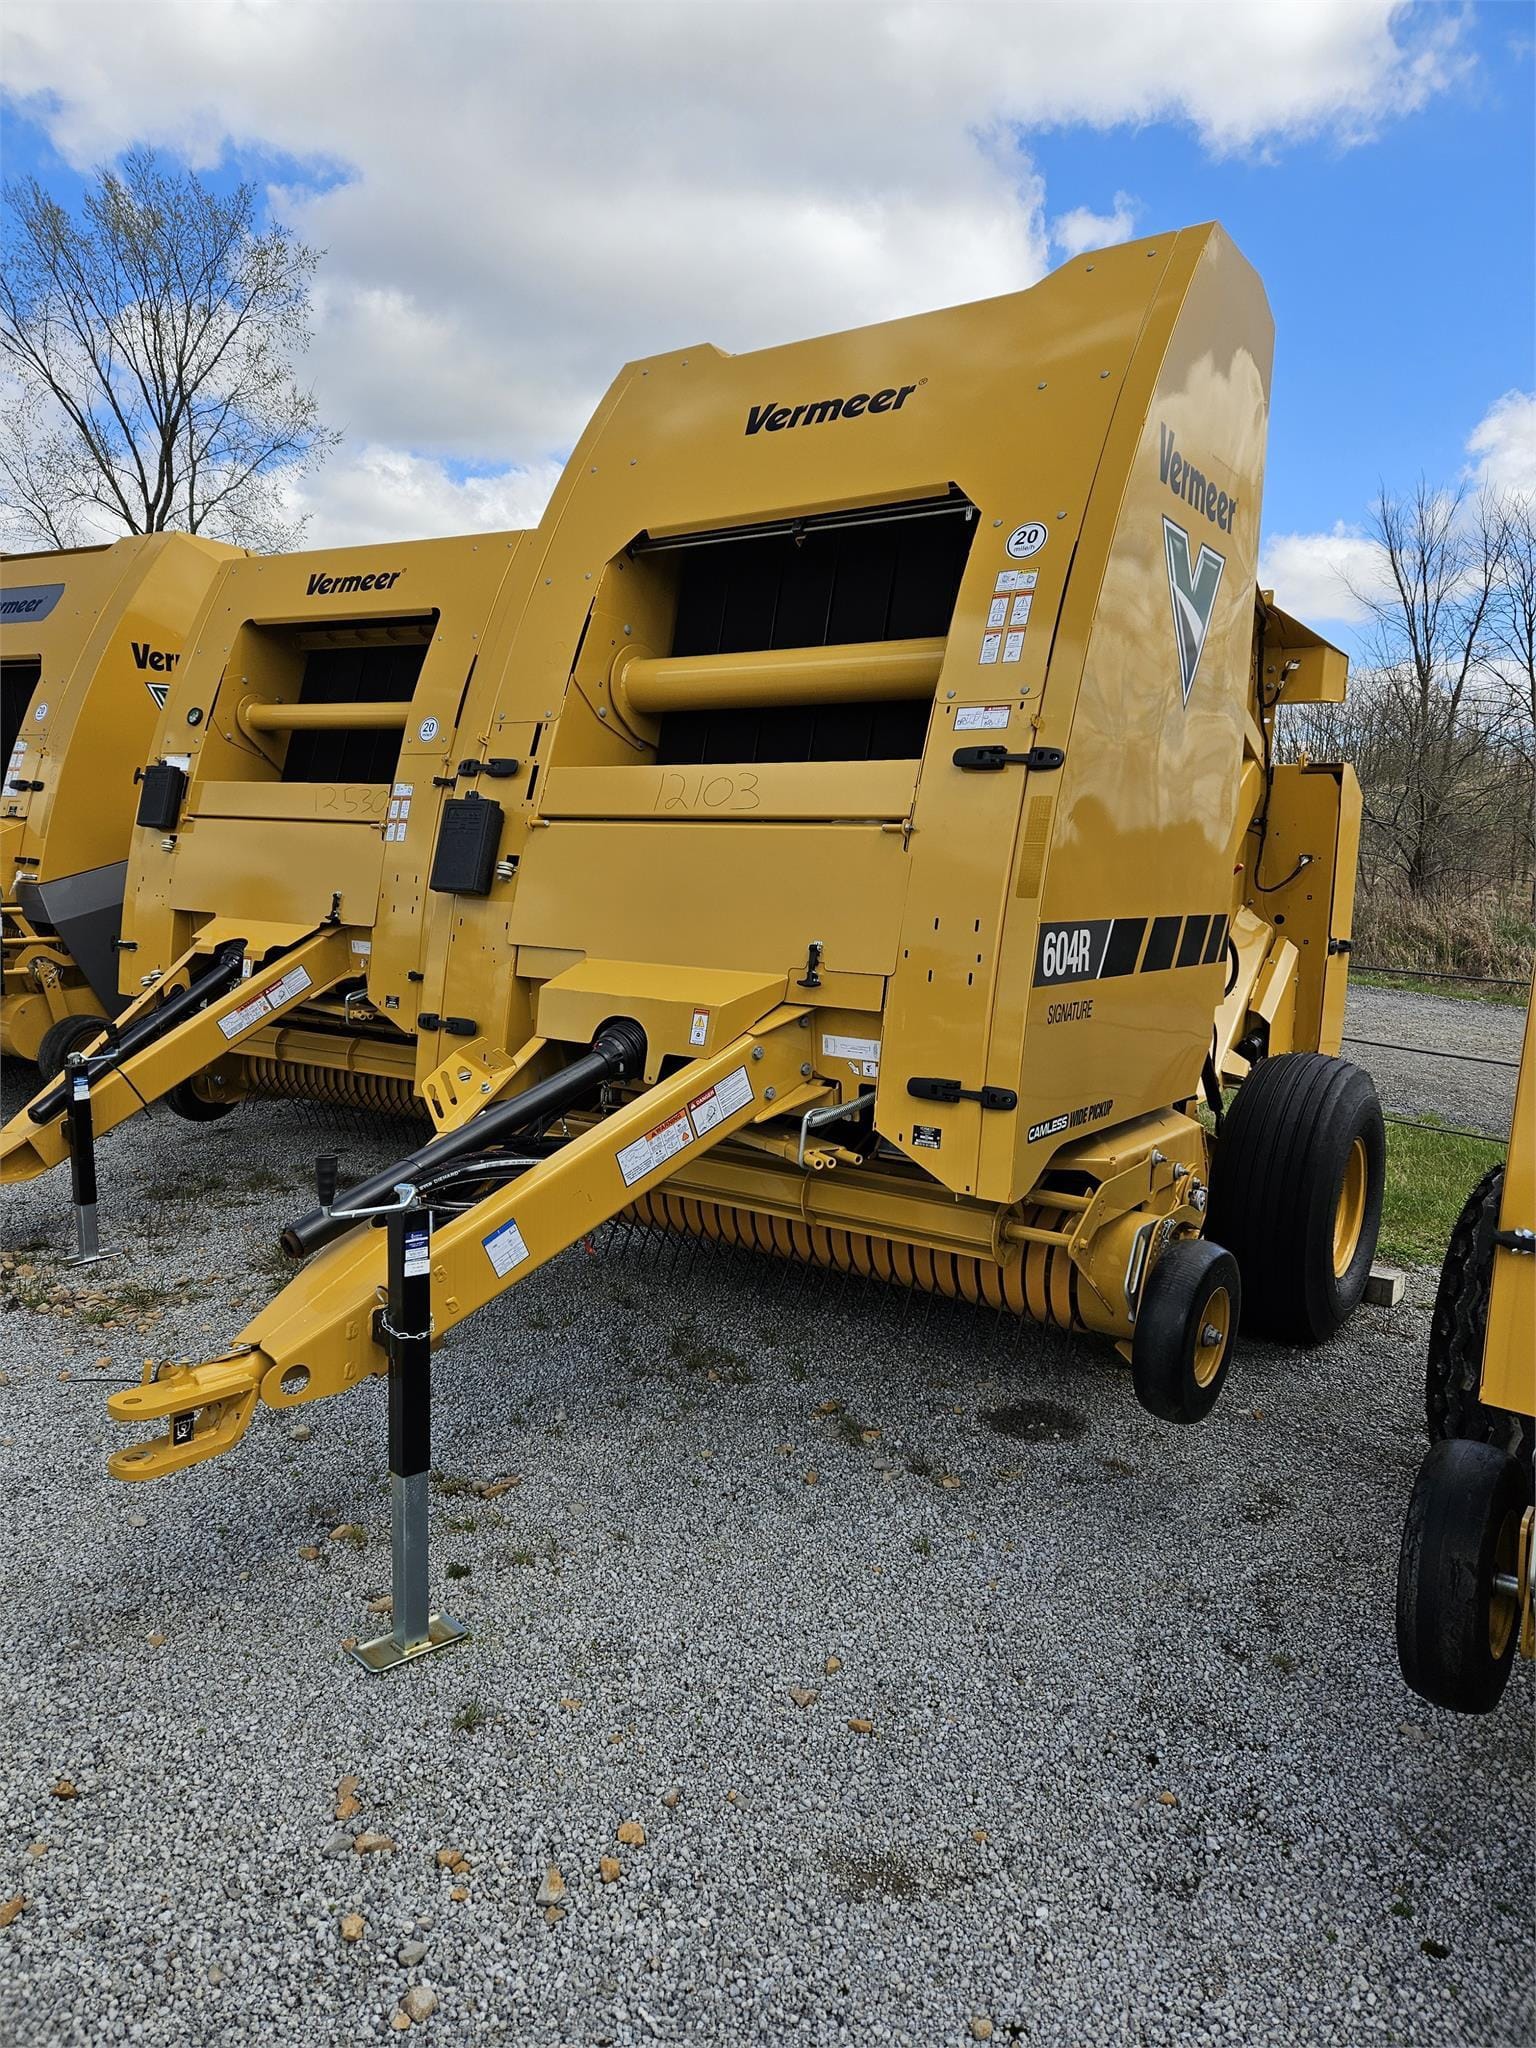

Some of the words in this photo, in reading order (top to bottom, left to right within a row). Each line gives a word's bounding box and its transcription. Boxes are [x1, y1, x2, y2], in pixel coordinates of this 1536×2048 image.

[745, 384, 917, 436] Vermeer
[1160, 421, 1238, 534] Vermeer
[1014, 529, 1039, 546] 20
[306, 572, 401, 595] Vermeer
[422, 722, 435, 732] 20
[314, 786, 389, 814] 12530
[653, 772, 760, 811] 12103
[1042, 929, 1091, 977] 604R
[1047, 1000, 1093, 1024] SIGNATURE
[695, 1089, 715, 1105] DANGER
[656, 1113, 682, 1134] WARNING
[1028, 1116, 1068, 1141] CAMLESS
[1069, 1107, 1088, 1128] WIDE
[1088, 1099, 1113, 1121] PICKUP
